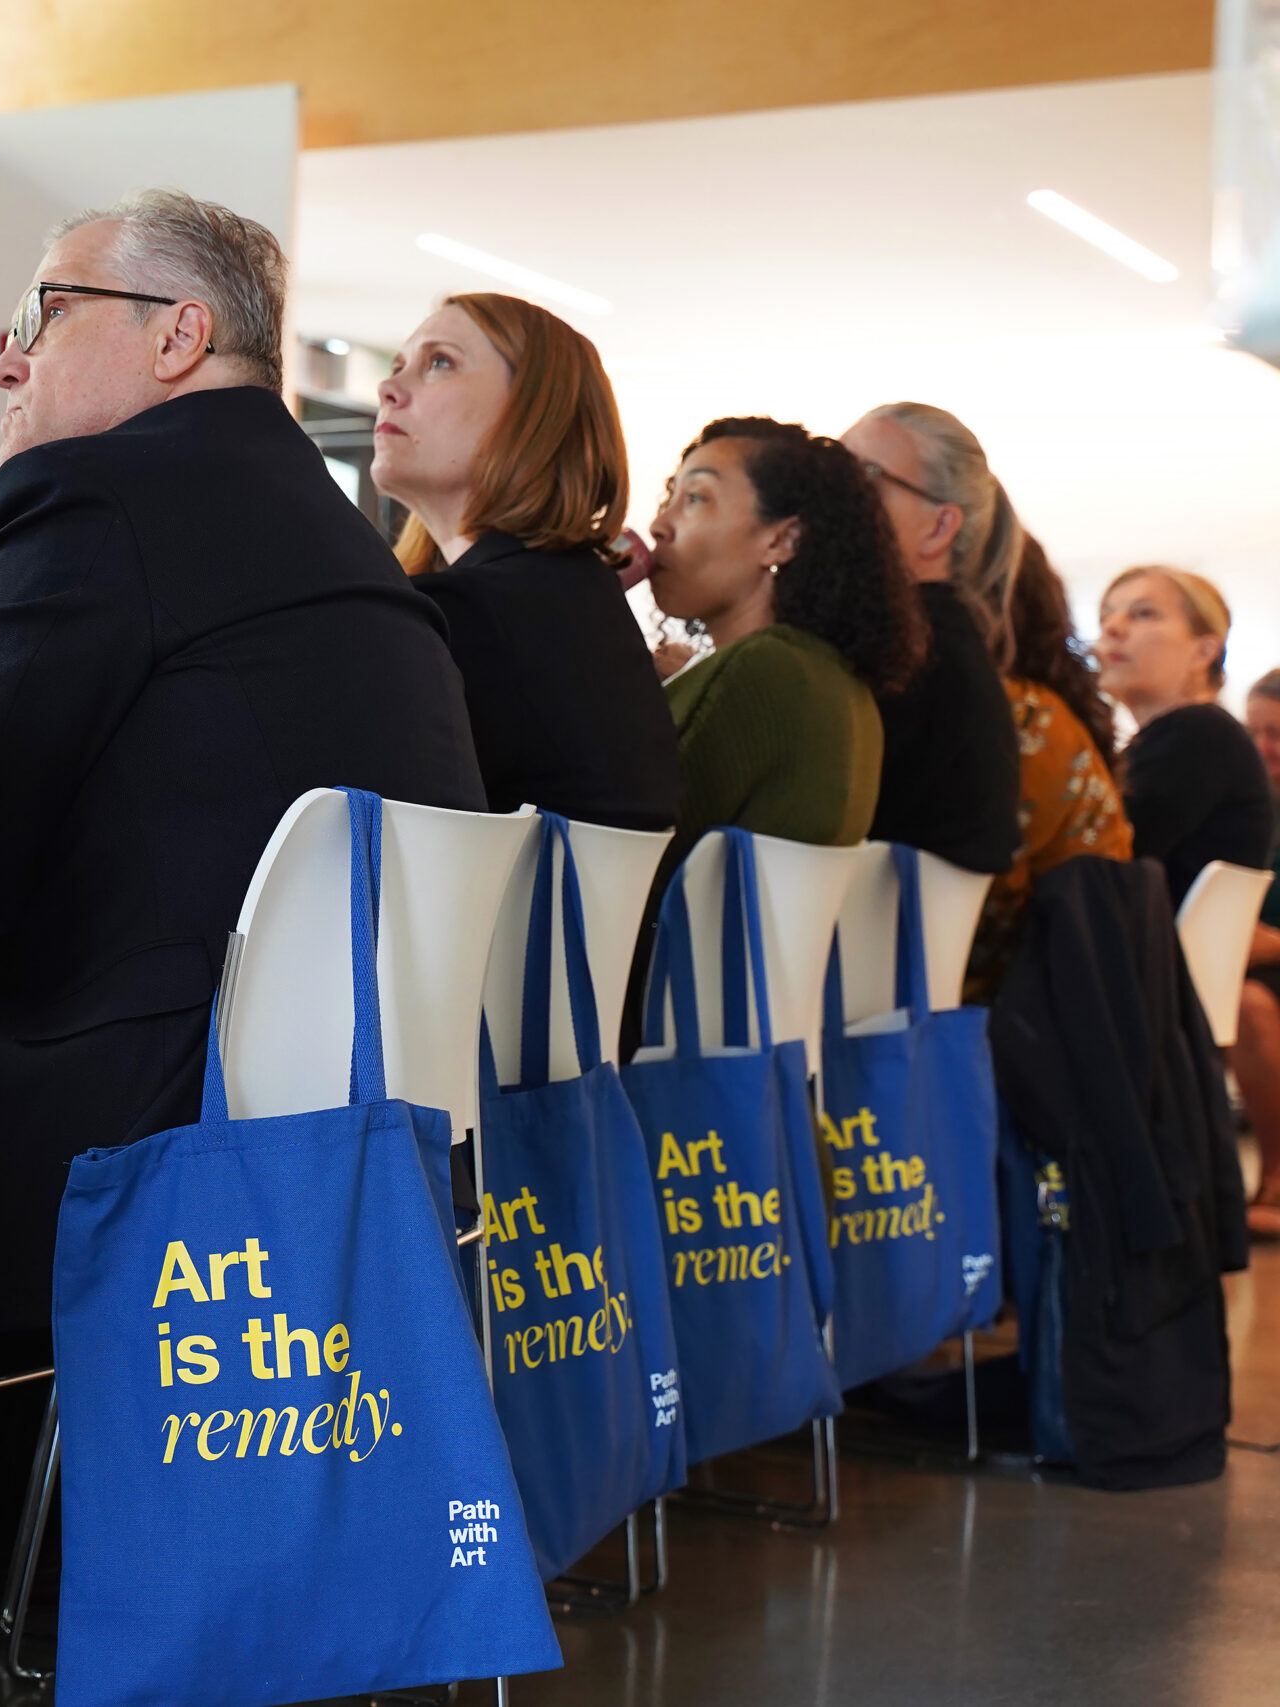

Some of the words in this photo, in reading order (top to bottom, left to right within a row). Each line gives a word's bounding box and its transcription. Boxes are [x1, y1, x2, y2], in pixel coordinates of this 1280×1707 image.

[657, 1130, 727, 1179] Art
[833, 1167, 857, 1200] s
[861, 1151, 926, 1194] the
[483, 1186, 546, 1248] Art
[663, 1188, 703, 1235] is
[713, 1181, 781, 1229] the
[830, 1183, 946, 1248] remed.
[152, 1237, 272, 1309] Art
[488, 1259, 526, 1313] is
[158, 1321, 221, 1387] is
[241, 1313, 351, 1380] the
[160, 1370, 403, 1463] remedy.
[448, 1499, 500, 1522] Path
[448, 1521, 498, 1544] with
[450, 1546, 487, 1568] Art
